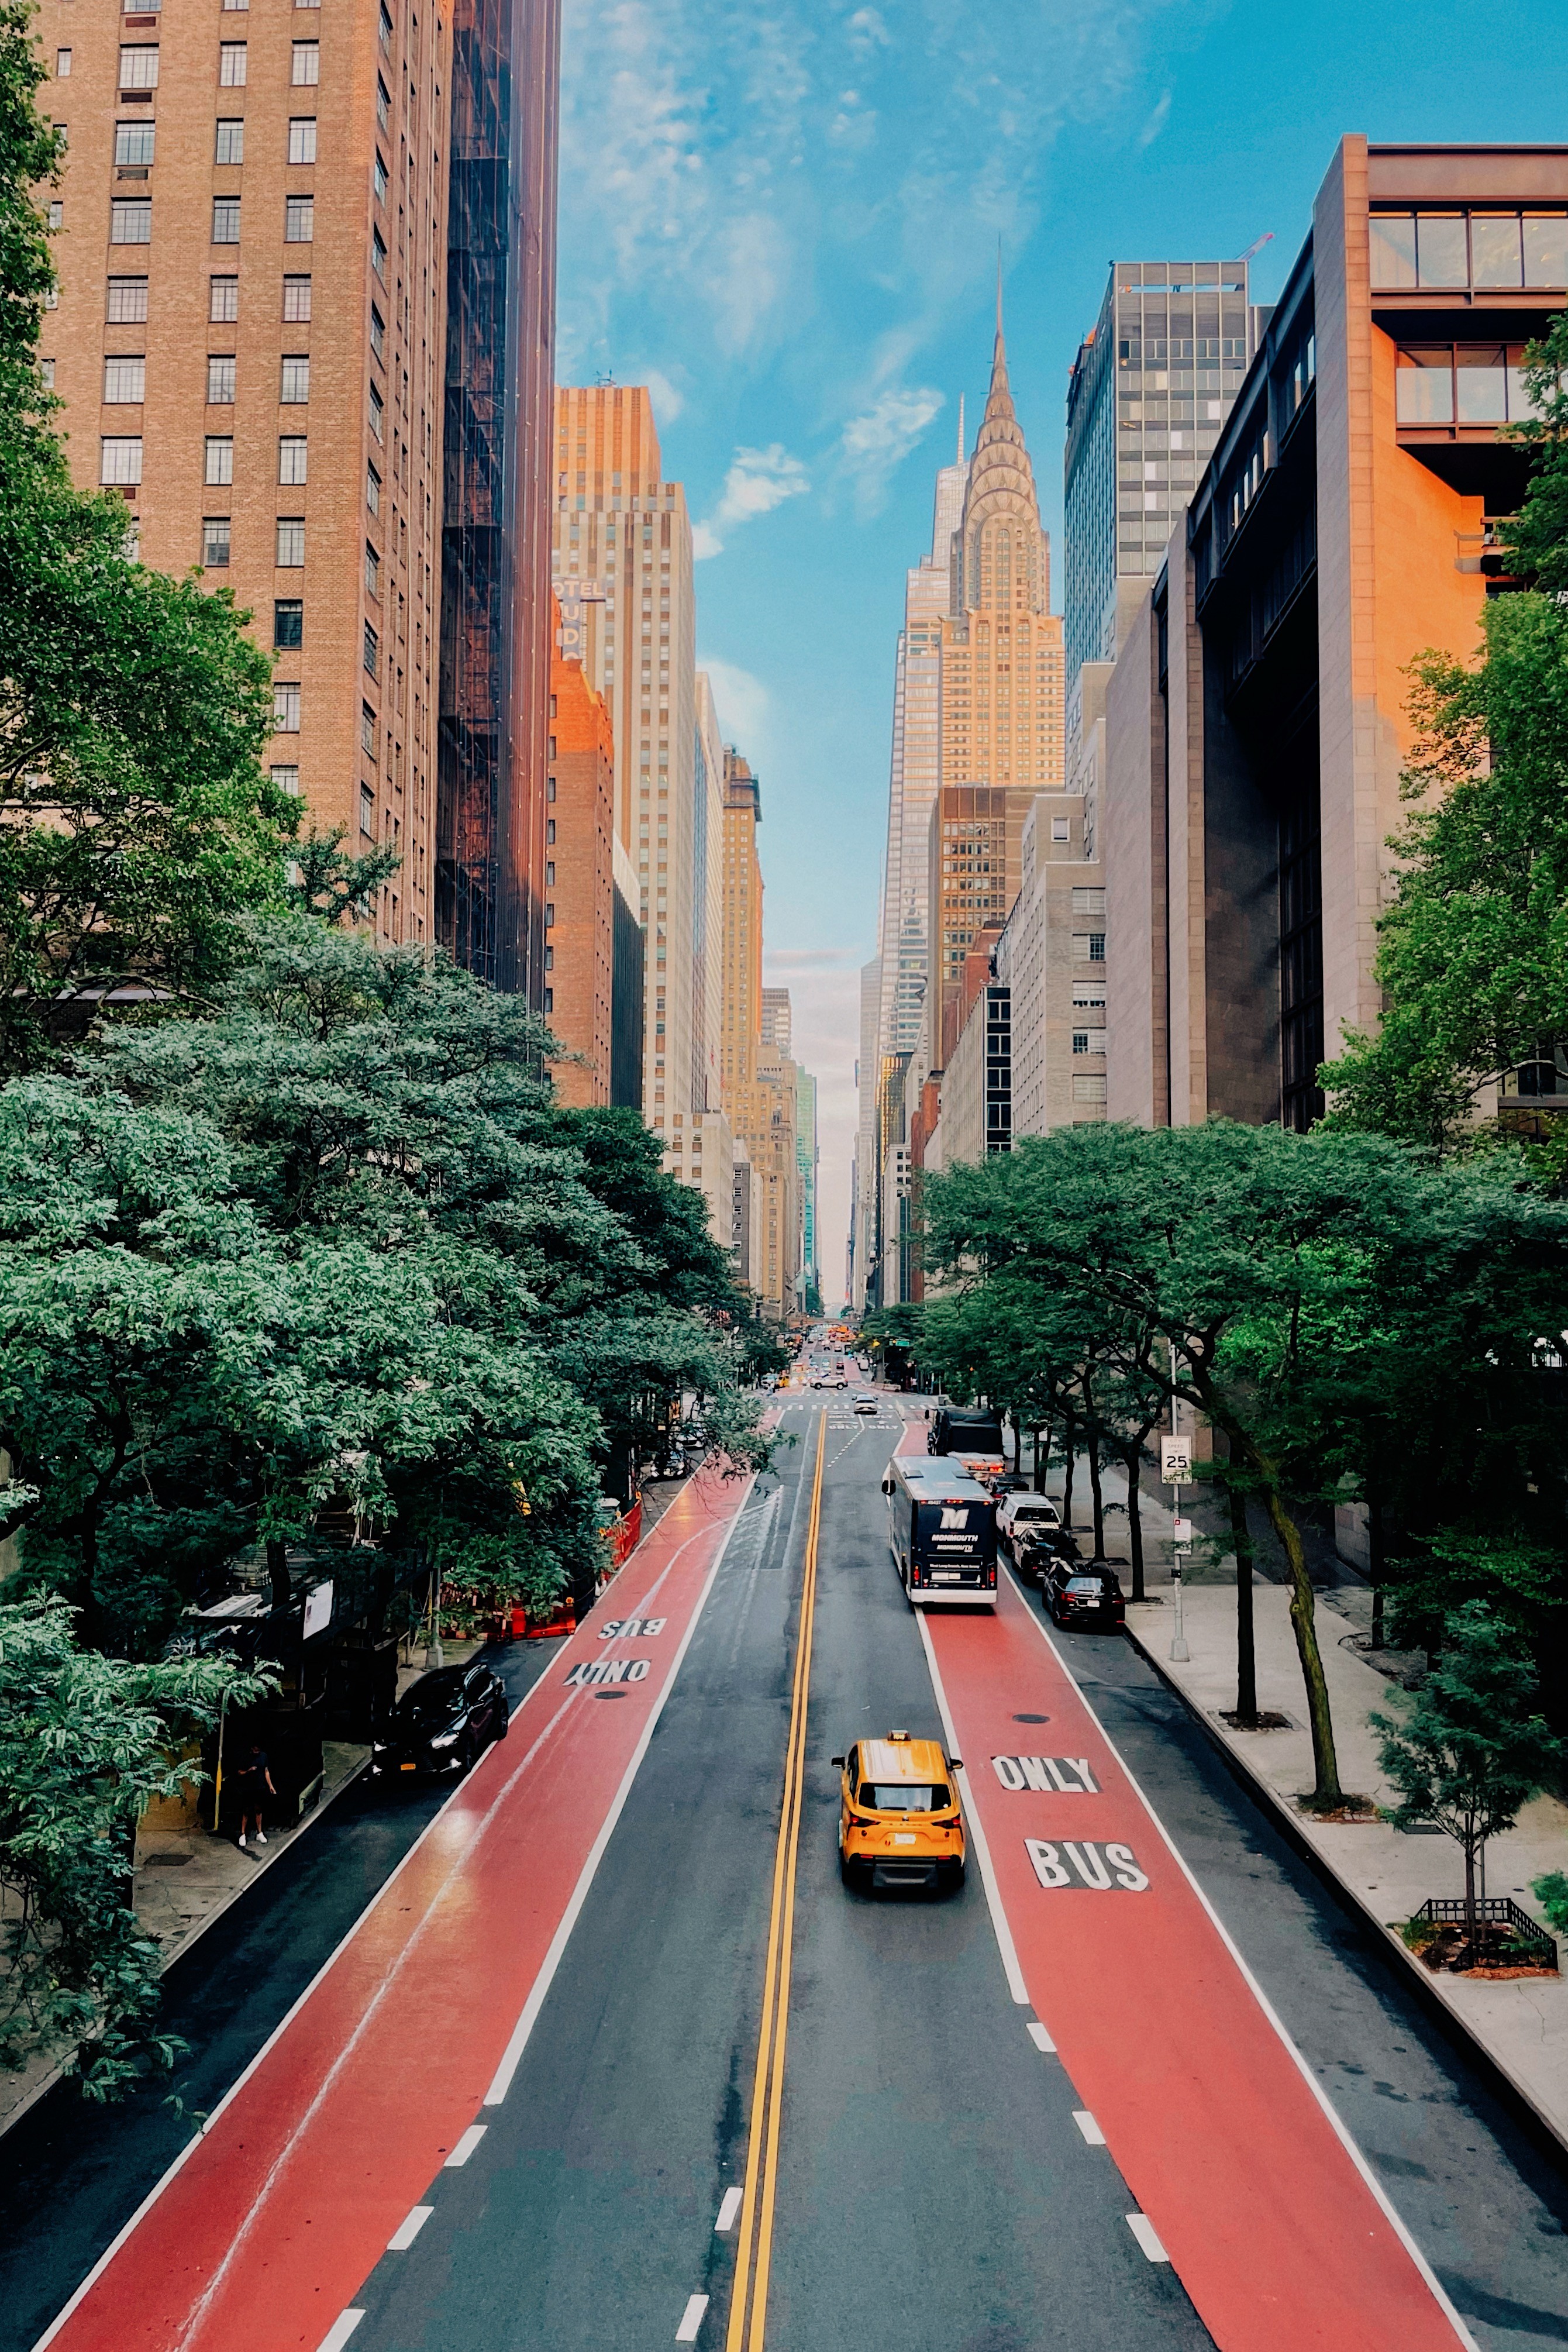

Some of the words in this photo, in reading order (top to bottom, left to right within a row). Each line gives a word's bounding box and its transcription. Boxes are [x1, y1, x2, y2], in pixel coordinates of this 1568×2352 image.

[1167, 1456, 1187, 1468] 25
[939, 1507, 970, 1529] M
[597, 1618, 668, 1640] BUS
[562, 1659, 651, 1686] ONLY
[991, 1756, 1098, 1793] ONLY
[1023, 1838, 1149, 1892] BUS
